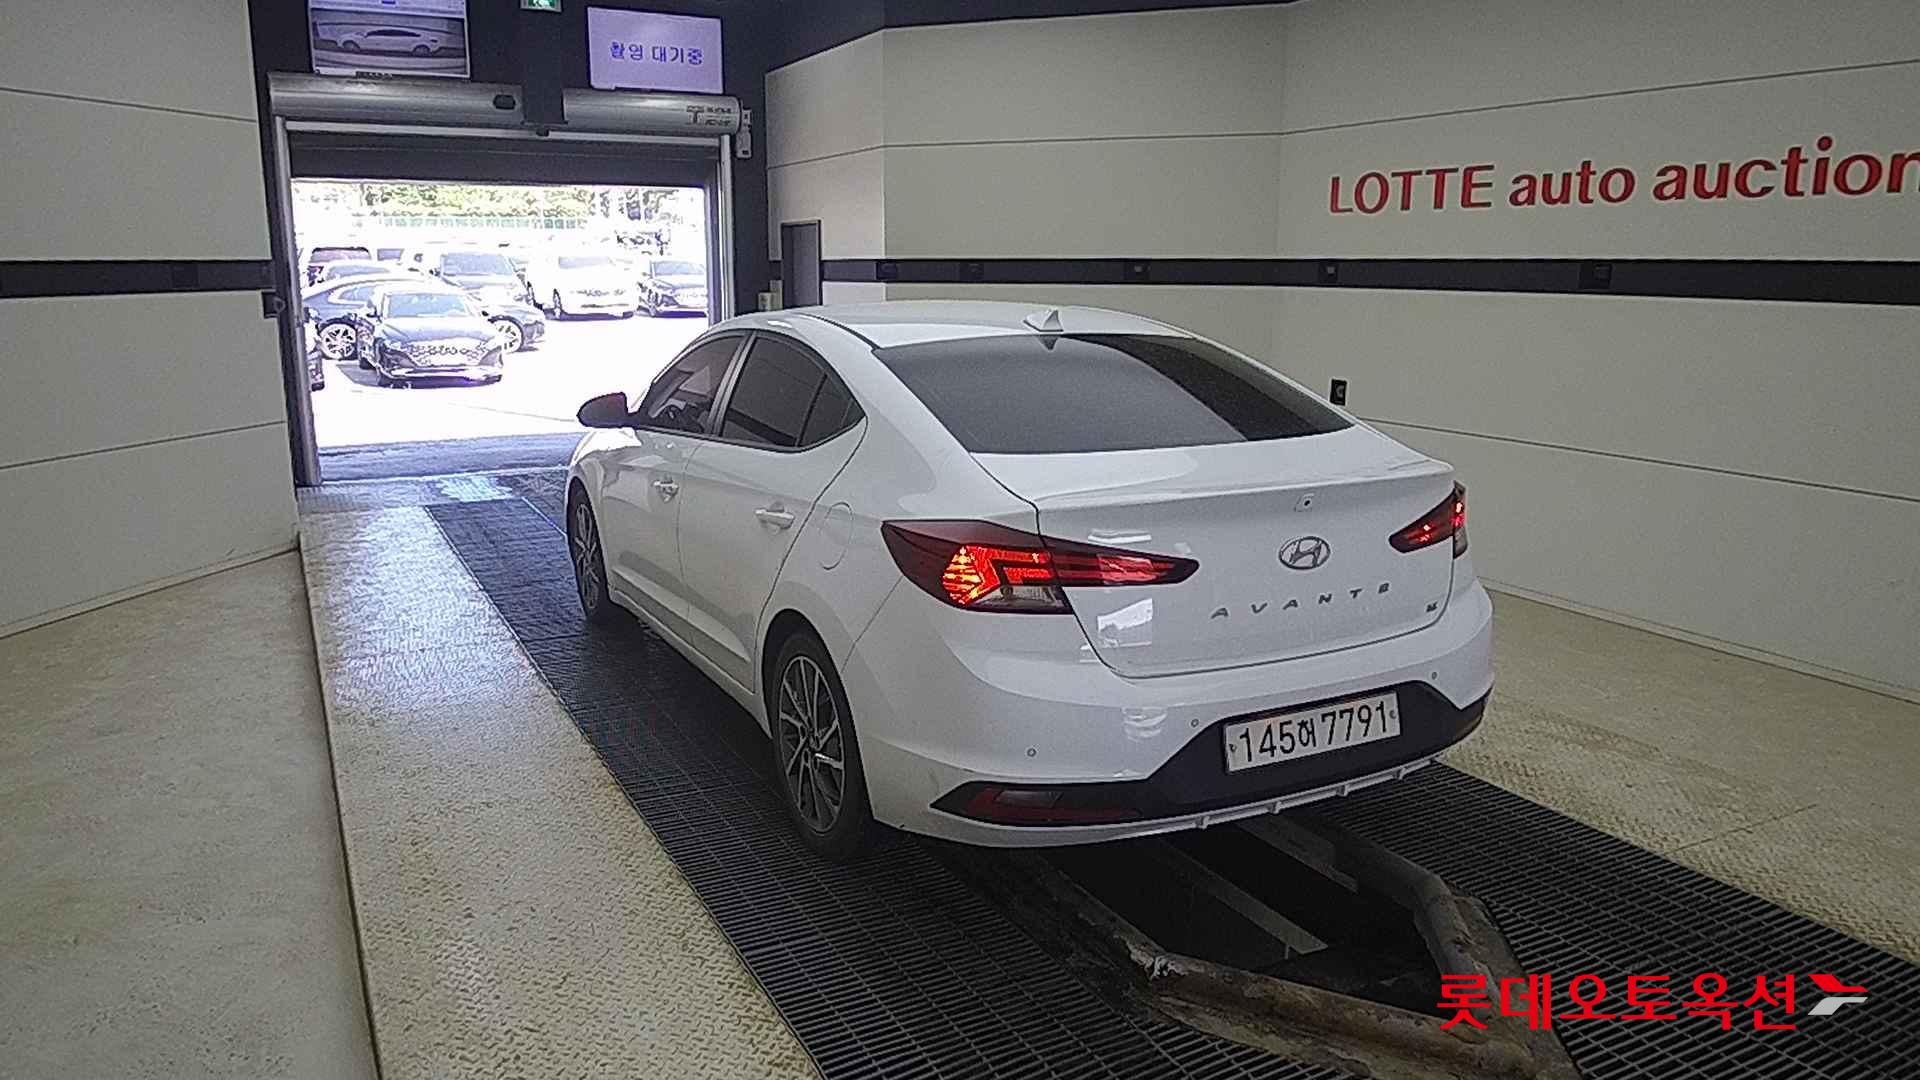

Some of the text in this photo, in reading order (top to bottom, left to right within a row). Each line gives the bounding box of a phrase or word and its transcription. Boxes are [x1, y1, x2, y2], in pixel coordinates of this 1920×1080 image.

[1330, 135, 1920, 214] LOTTE auto auction
[1210, 582, 1390, 619] AVANTE
